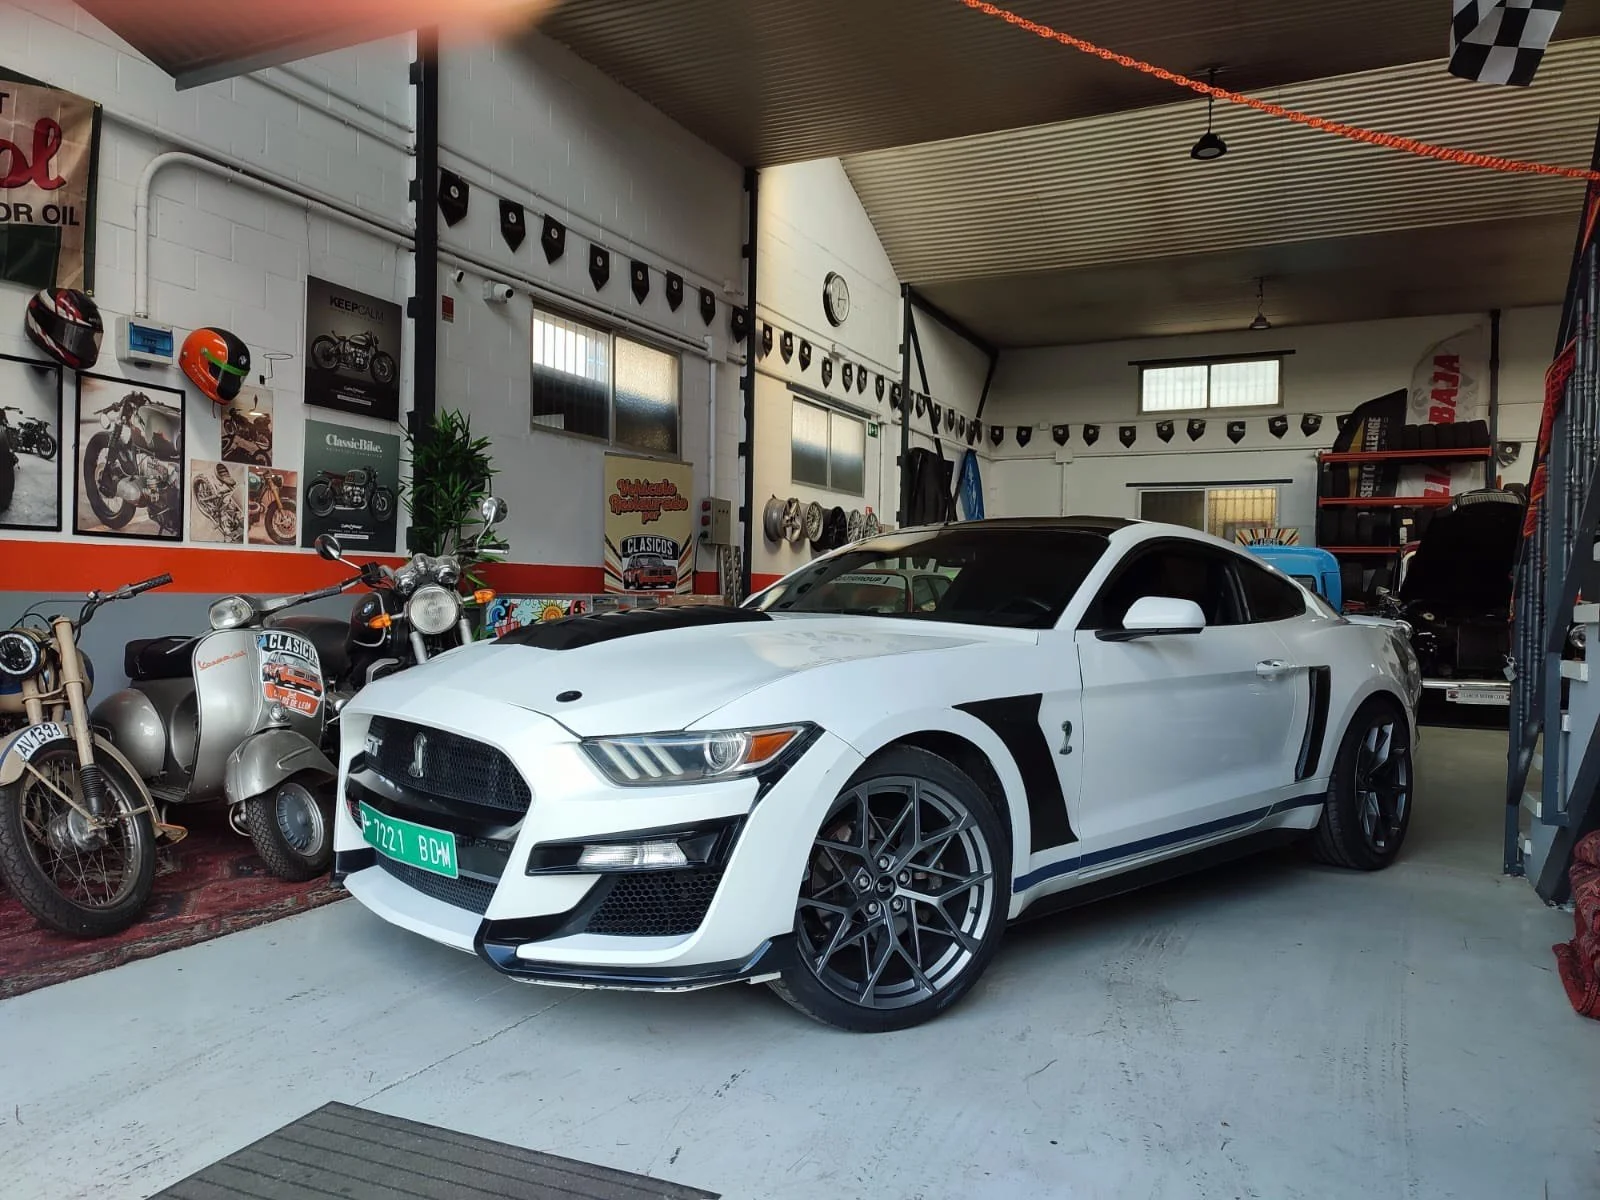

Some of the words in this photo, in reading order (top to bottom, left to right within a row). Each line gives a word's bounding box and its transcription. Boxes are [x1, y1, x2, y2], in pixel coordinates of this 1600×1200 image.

[42, 204, 80, 226] OIL
[1428, 355, 1460, 424] BAJA
[627, 538, 673, 555] CLASICOS
[374, 819, 405, 855] 7221
[418, 834, 451, 869] BDM
